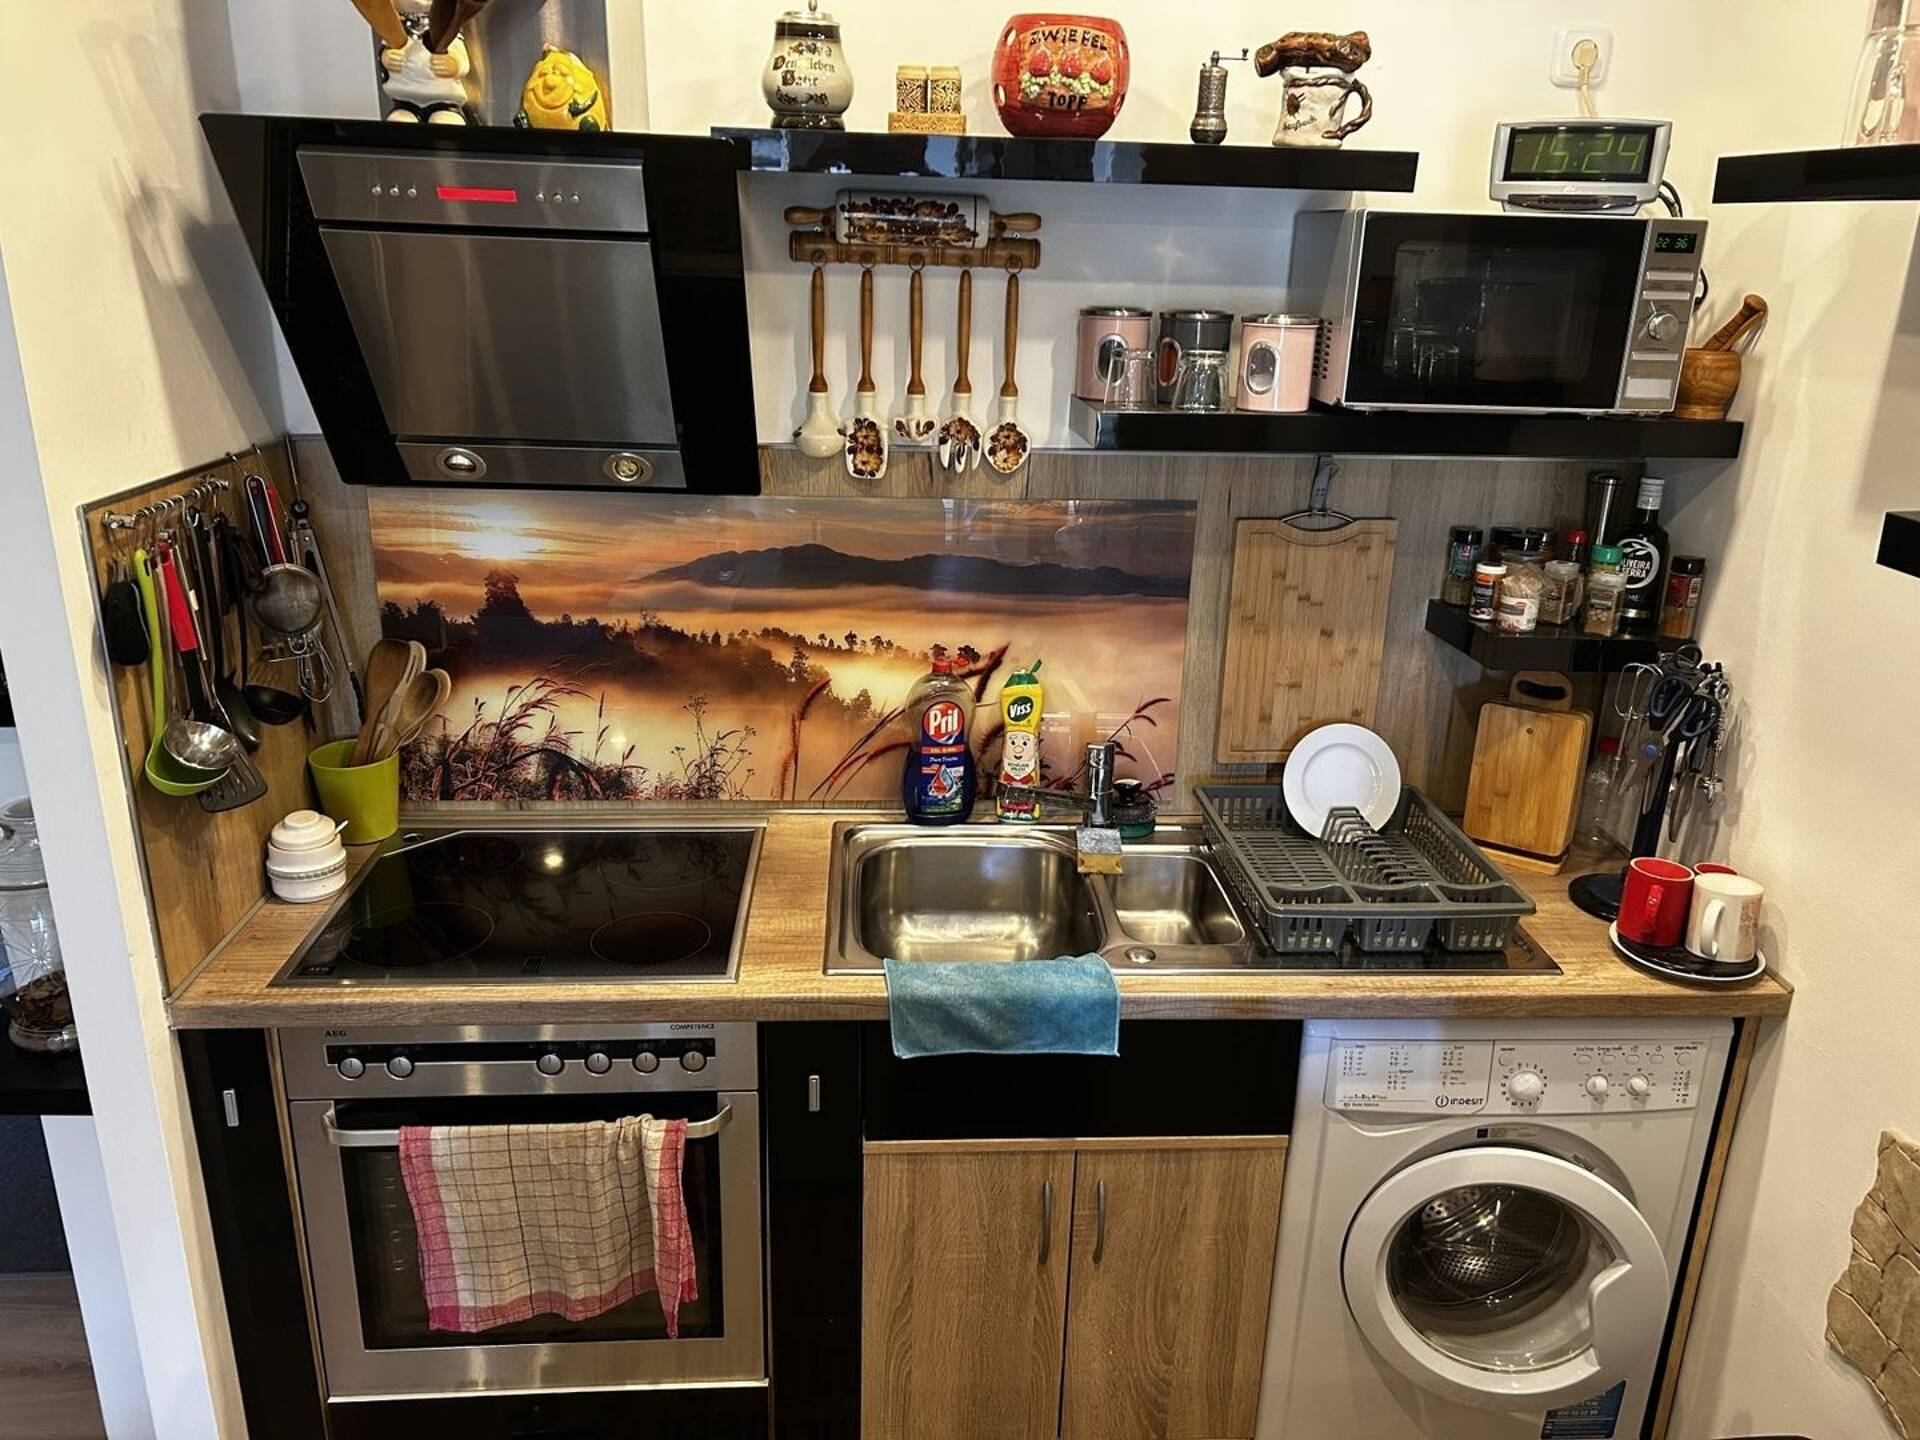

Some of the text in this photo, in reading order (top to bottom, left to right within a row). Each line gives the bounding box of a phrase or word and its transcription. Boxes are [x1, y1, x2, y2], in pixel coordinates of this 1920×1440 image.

[1531, 133, 1645, 173] 15:24
[1620, 556, 1651, 572] LIVEIRA
[928, 708, 959, 736] Pril
